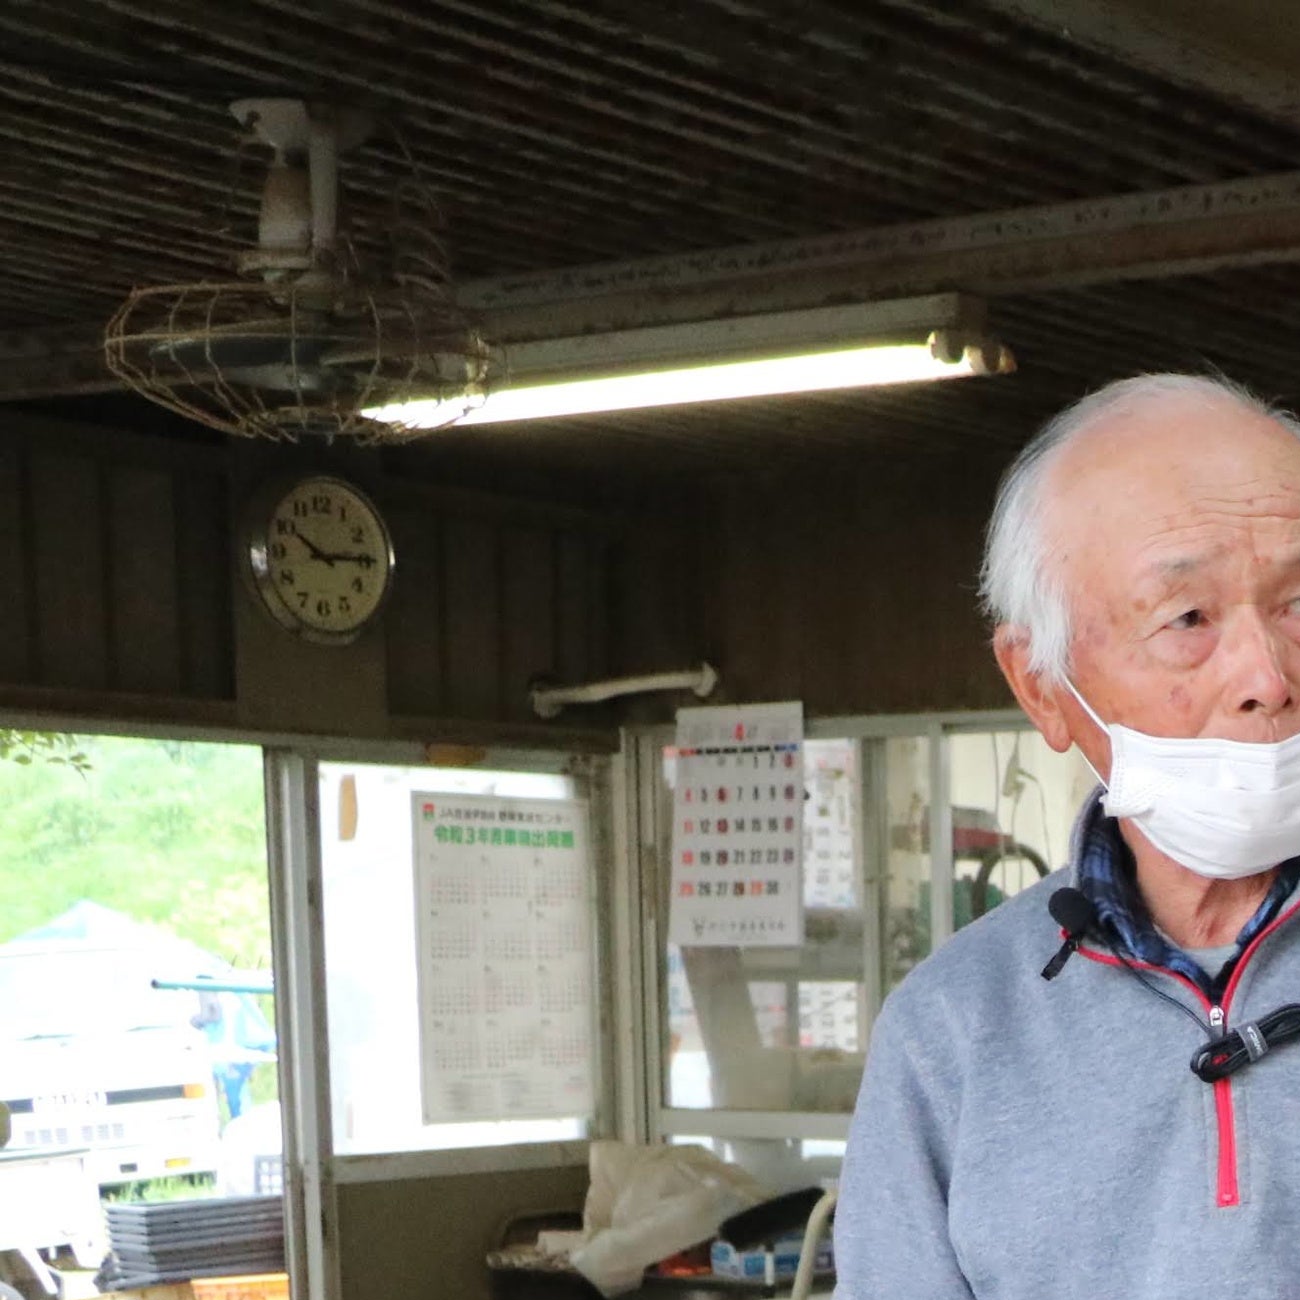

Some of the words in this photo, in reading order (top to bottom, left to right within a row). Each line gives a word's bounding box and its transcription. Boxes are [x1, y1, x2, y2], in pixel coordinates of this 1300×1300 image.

[293, 501, 308, 518] 11
[312, 496, 331, 515] 12
[338, 506, 347, 522] 1
[276, 519, 296, 536] 10
[350, 526, 364, 543] 2
[280, 569, 295, 585] 8
[351, 577, 363, 593] 4
[296, 590, 309, 609] 7
[338, 596, 351, 612] 5
[316, 600, 332, 617] 6
